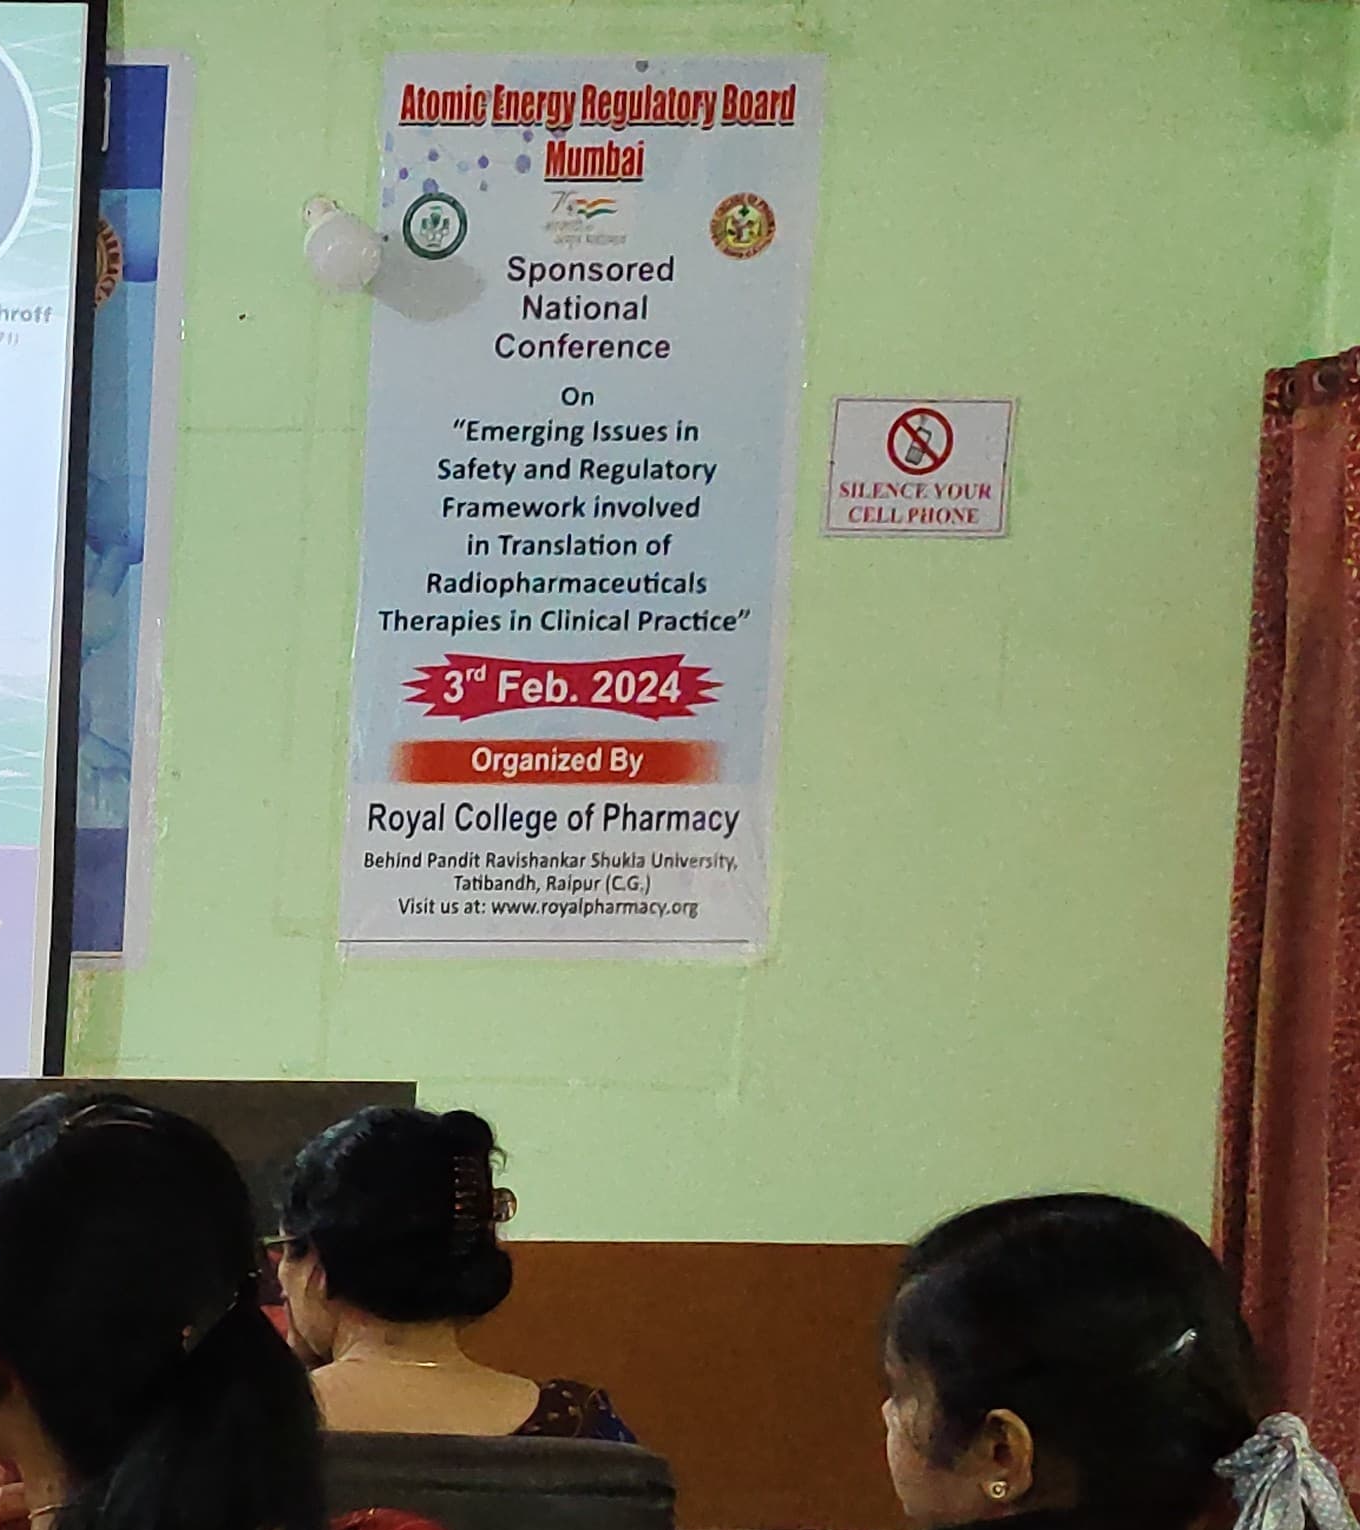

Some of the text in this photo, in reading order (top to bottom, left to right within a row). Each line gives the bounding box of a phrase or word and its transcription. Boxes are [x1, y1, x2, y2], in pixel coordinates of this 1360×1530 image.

[400, 84, 795, 129] Atomic Energy Regulatory Board
[544, 141, 644, 180] Mumbai
[507, 256, 675, 286] Sponsored
[522, 295, 647, 321] National
[495, 334, 670, 359] Conference
[839, 481, 992, 499] SILENCE YOUR
[848, 506, 980, 524] CELL PHONE
[443, 665, 680, 703] 3rd Feb. 2024
[368, 803, 739, 838] Royal College of Pharmacy
[364, 852, 738, 873] Behind Pandit Ravishankar Shukla University,
[454, 875, 651, 895] Tatibandh, Raipur (C.G.)
[398, 898, 698, 919] Visit us at: www.royalpharmacy.org
